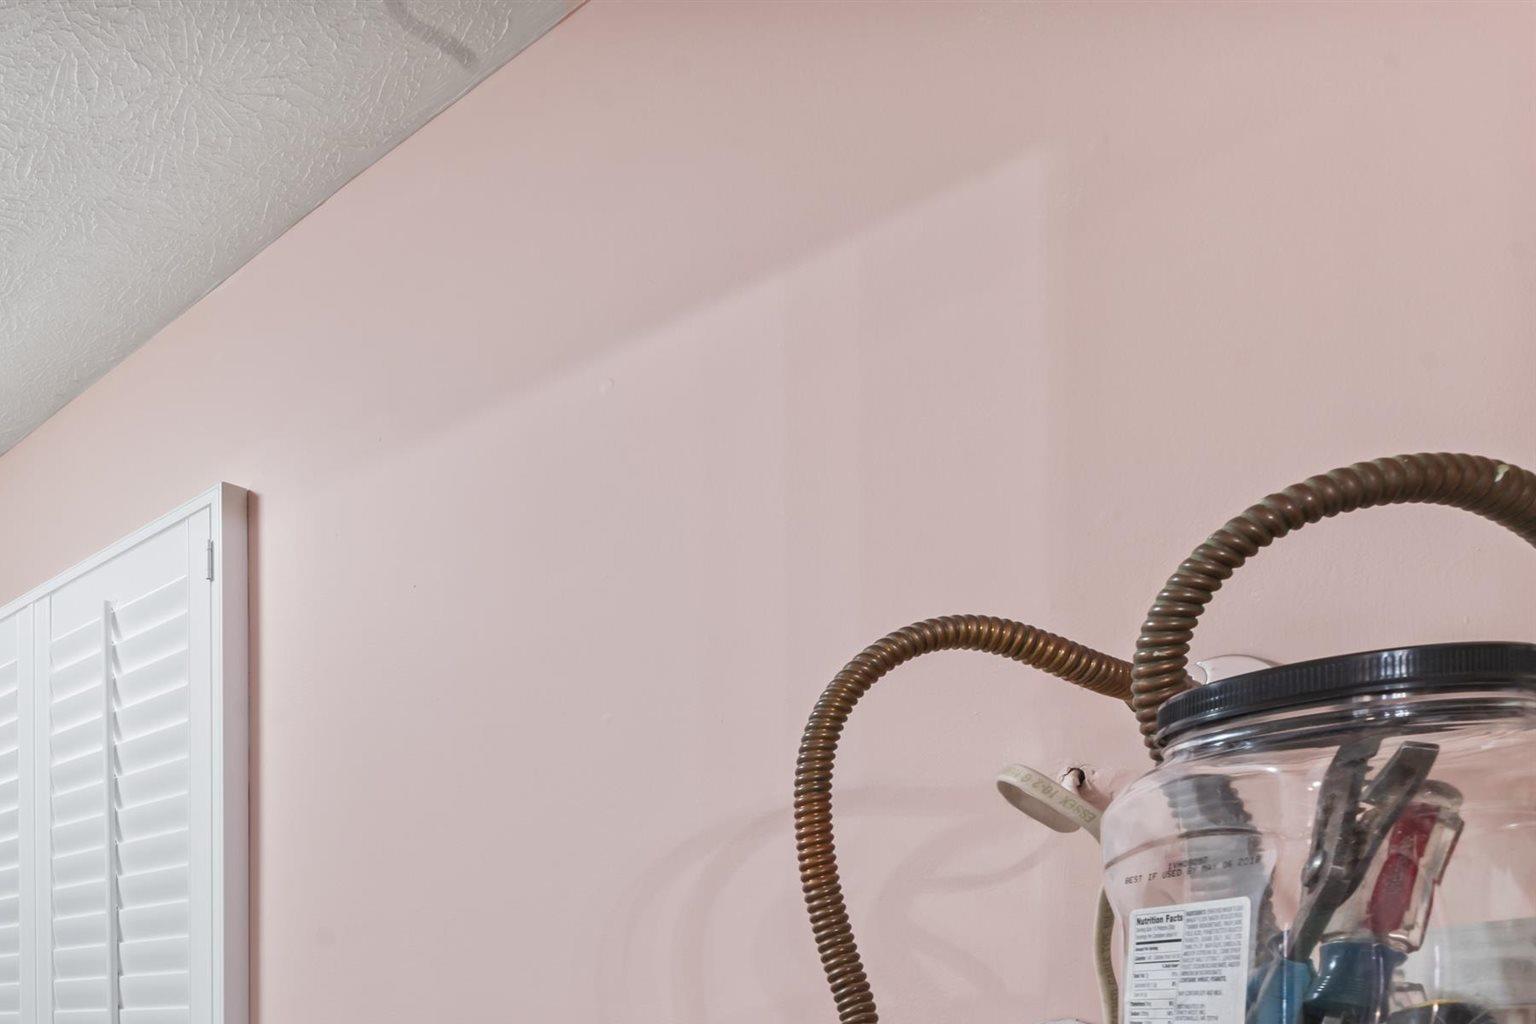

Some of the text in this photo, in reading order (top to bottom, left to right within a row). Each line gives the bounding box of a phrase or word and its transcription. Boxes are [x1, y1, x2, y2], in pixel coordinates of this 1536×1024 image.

[1147, 872, 1158, 881] IF
[1162, 868, 1182, 879] USED
[1136, 912, 1183, 926] Nutrition Facts
